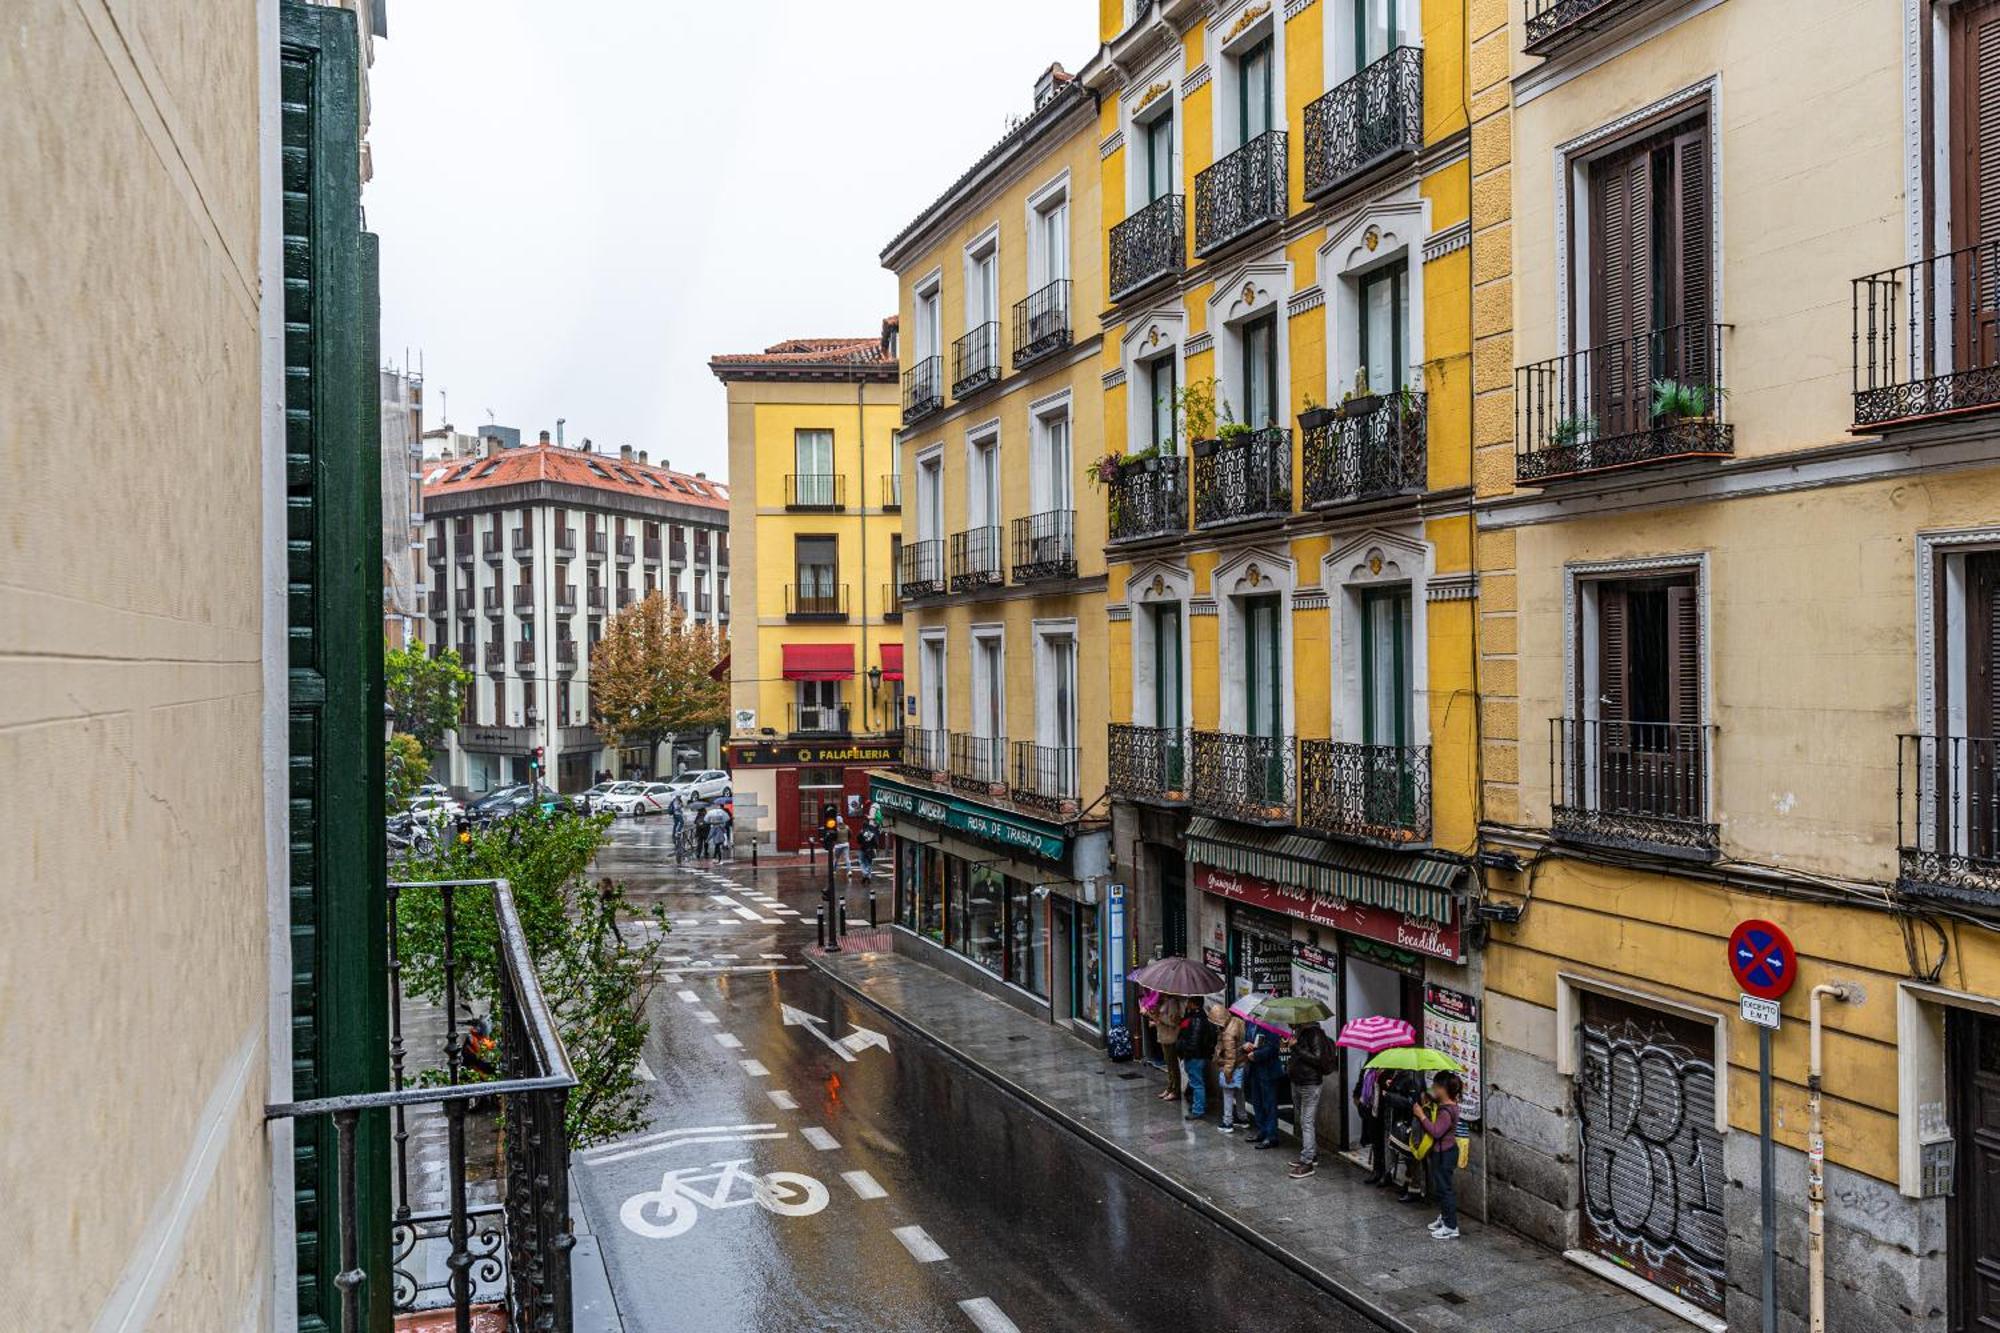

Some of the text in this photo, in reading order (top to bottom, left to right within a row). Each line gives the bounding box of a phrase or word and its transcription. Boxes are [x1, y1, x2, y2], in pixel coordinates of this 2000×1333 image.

[819, 749, 890, 760] FALAFELERIA
[967, 816, 1042, 849] ROPA DE TRABAJO
[1743, 1000, 1777, 1015] EXCEPTO
